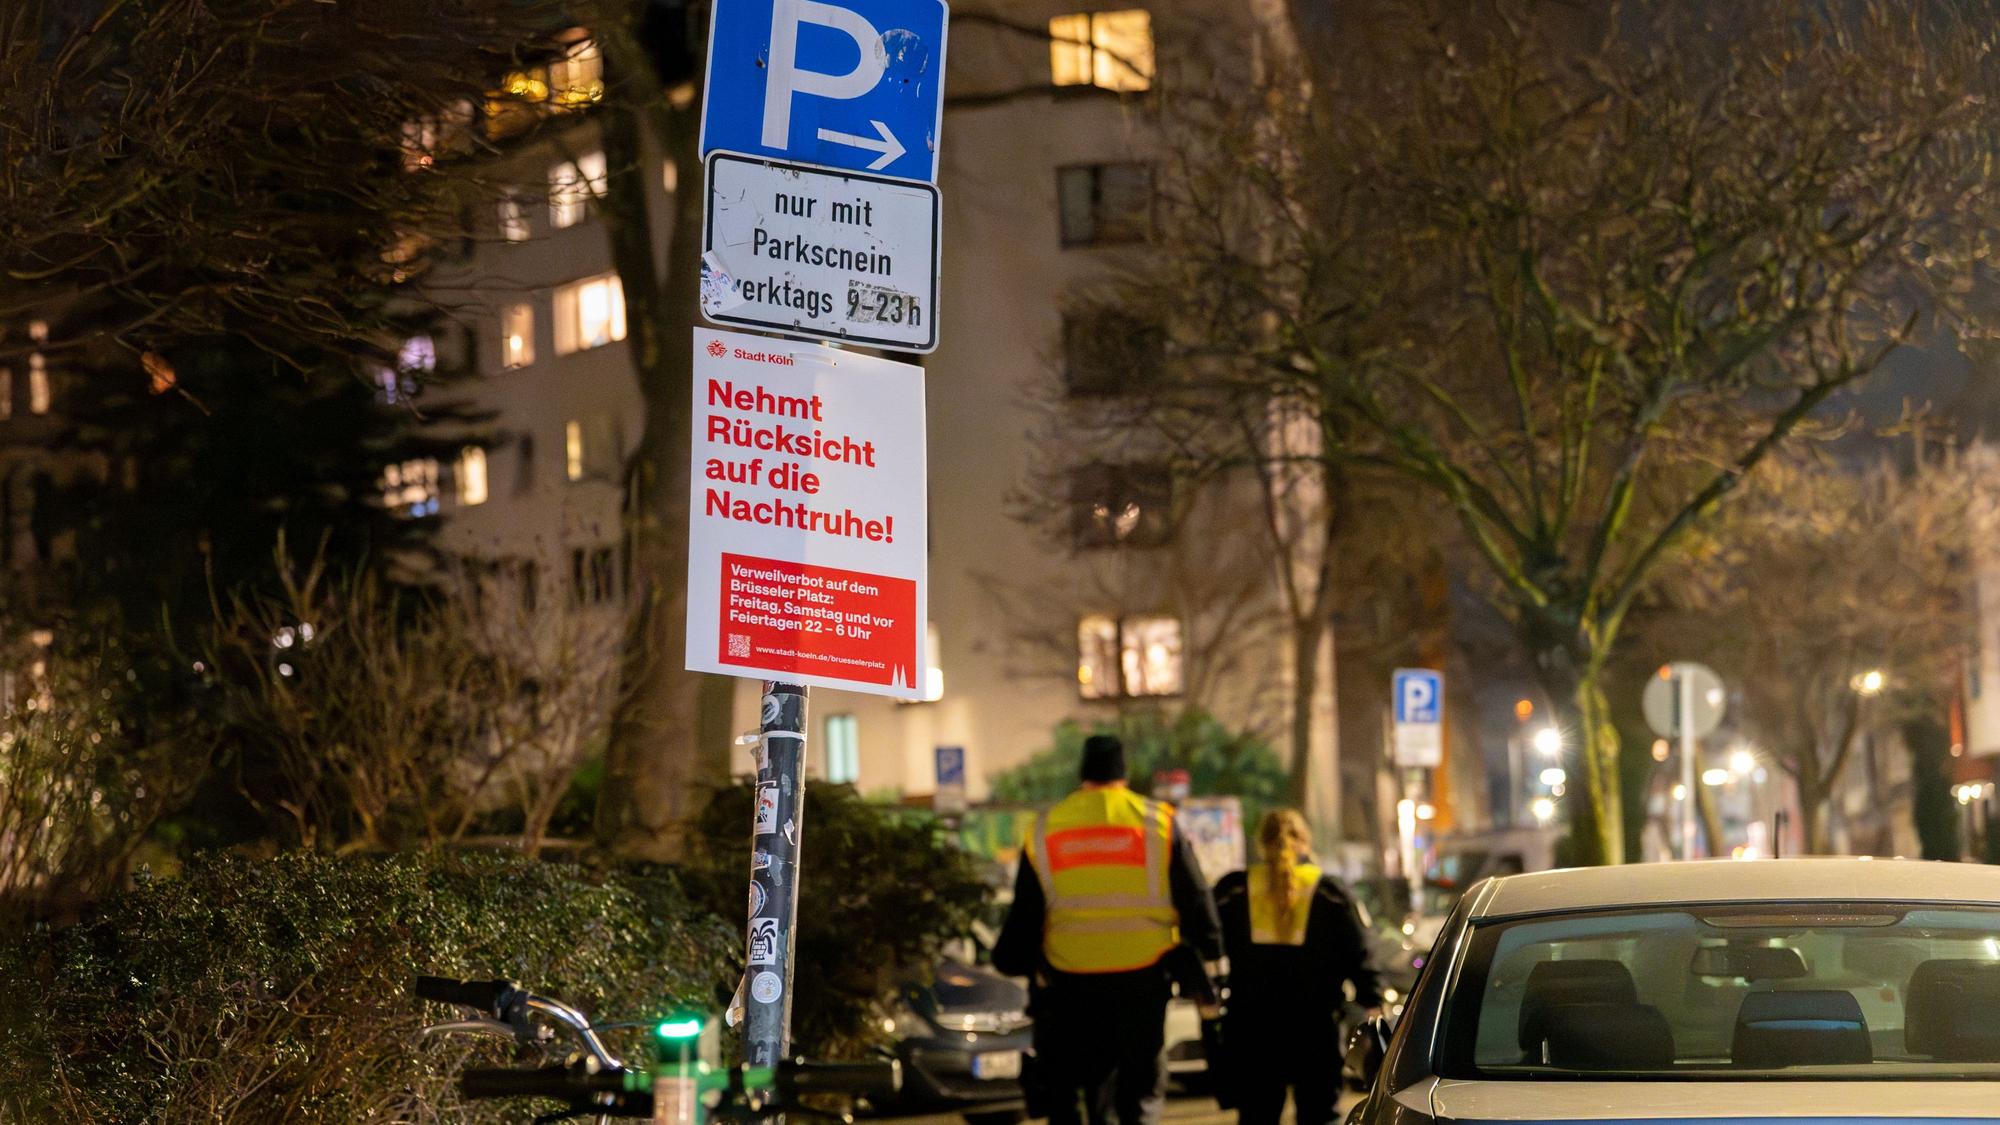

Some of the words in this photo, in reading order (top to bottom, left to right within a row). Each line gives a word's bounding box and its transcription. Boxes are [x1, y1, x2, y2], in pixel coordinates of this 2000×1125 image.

[761, 0, 885, 150] P
[775, 191, 817, 218] nur
[831, 197, 873, 227] mit
[736, 276, 833, 319] erktags
[734, 348, 765, 362] Stadt
[768, 353, 794, 366] Köln
[708, 378, 823, 422] Nehmt
[707, 414, 876, 468] Rücksicht
[705, 458, 763, 486] auf
[768, 462, 820, 495] die
[705, 488, 894, 544] Nachtruhe!
[730, 563, 824, 588] Verweilverbot
[826, 580, 848, 592] auf
[849, 582, 879, 596] dem
[730, 580, 794, 600] Brüsseler
[797, 588, 835, 605] Platz:
[729, 594, 782, 614] Freitag,
[783, 602, 843, 623] Samstag
[845, 610, 871, 625] und
[872, 616, 894, 628] vor
[729, 609, 802, 631] Feiertagen
[804, 619, 823, 633] 22
[835, 623, 845, 637] 6
[847, 625, 872, 640] Uhr
[755, 646, 886, 669] www.stadt-koeln.de/bruesselerplatz
[1404, 678, 1433, 721] P
